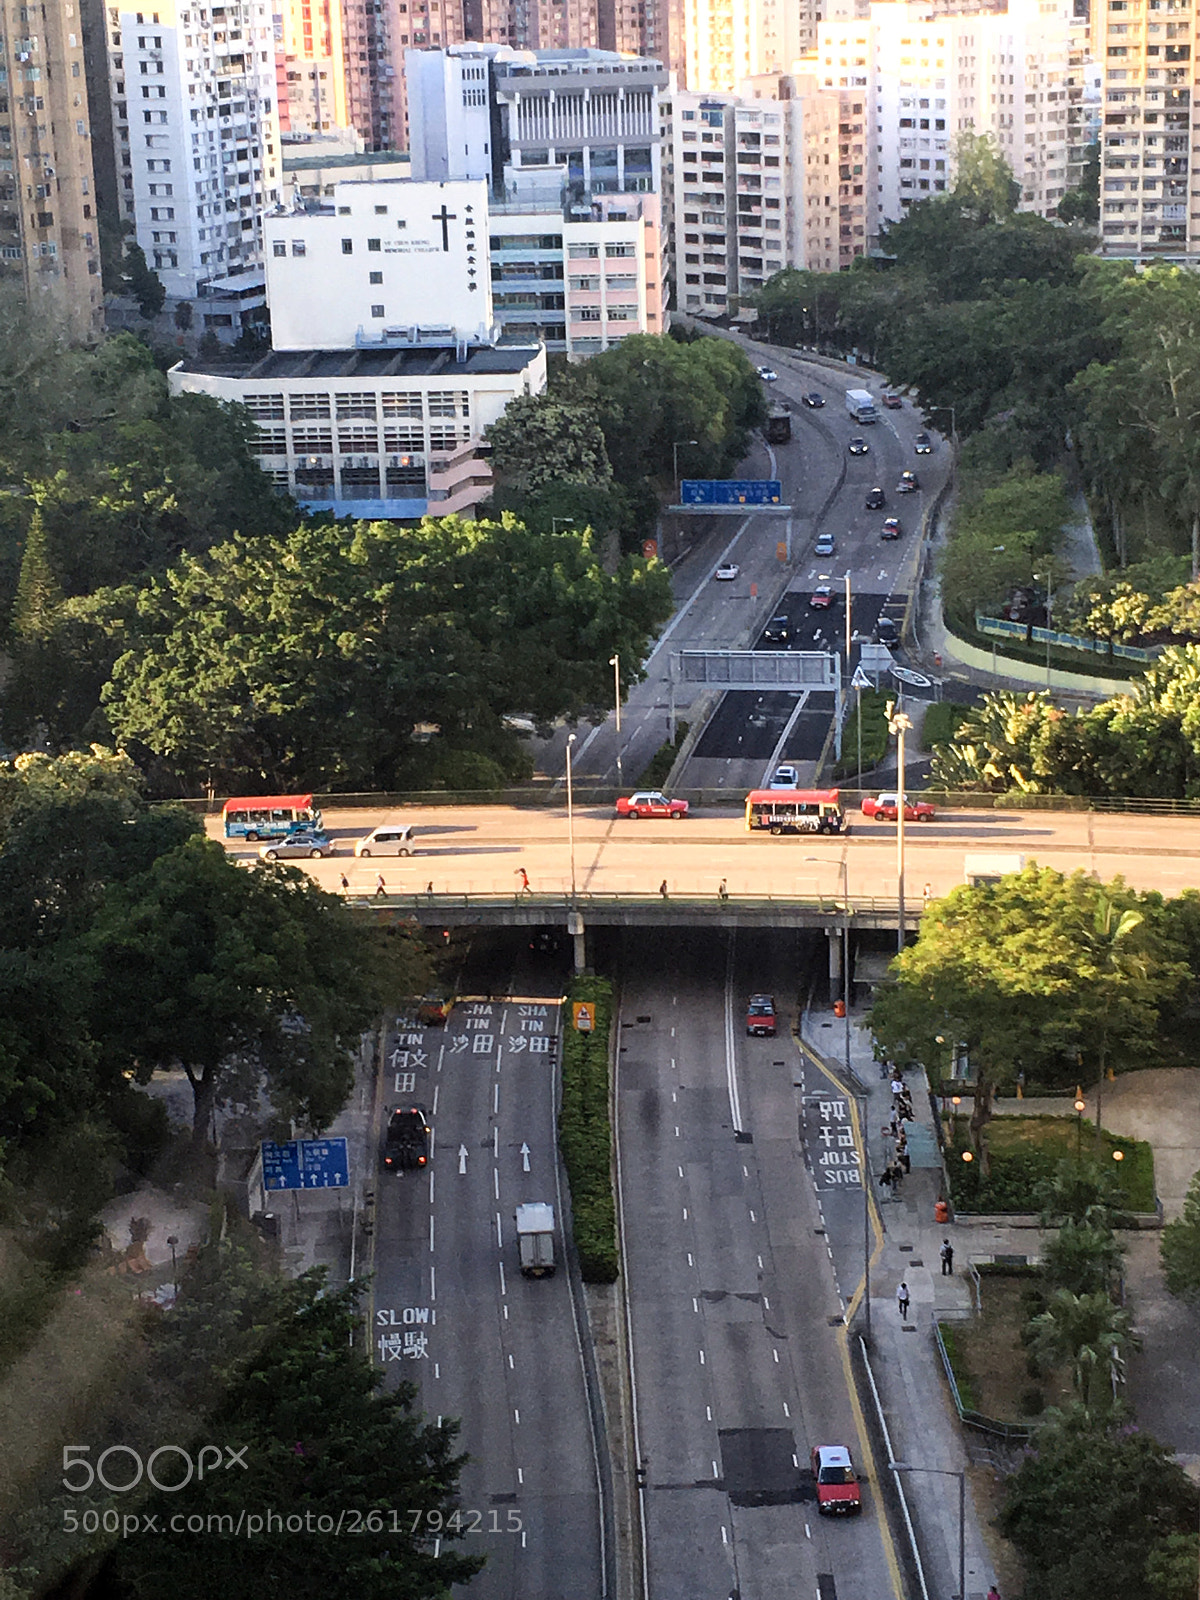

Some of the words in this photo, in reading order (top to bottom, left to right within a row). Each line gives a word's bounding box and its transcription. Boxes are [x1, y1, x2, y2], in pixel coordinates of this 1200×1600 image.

[517, 1006, 548, 1017] SHA
[466, 1018, 490, 1030] TIN
[520, 1020, 544, 1032] TIN
[397, 1033, 424, 1045] TIN
[450, 1034, 494, 1054] 沙田
[508, 1035, 550, 1054] 沙田
[819, 1151, 861, 1165] STOP
[824, 1169, 861, 1184] BUS
[376, 1307, 429, 1326] SLOW
[377, 1331, 430, 1362] 慢駛
